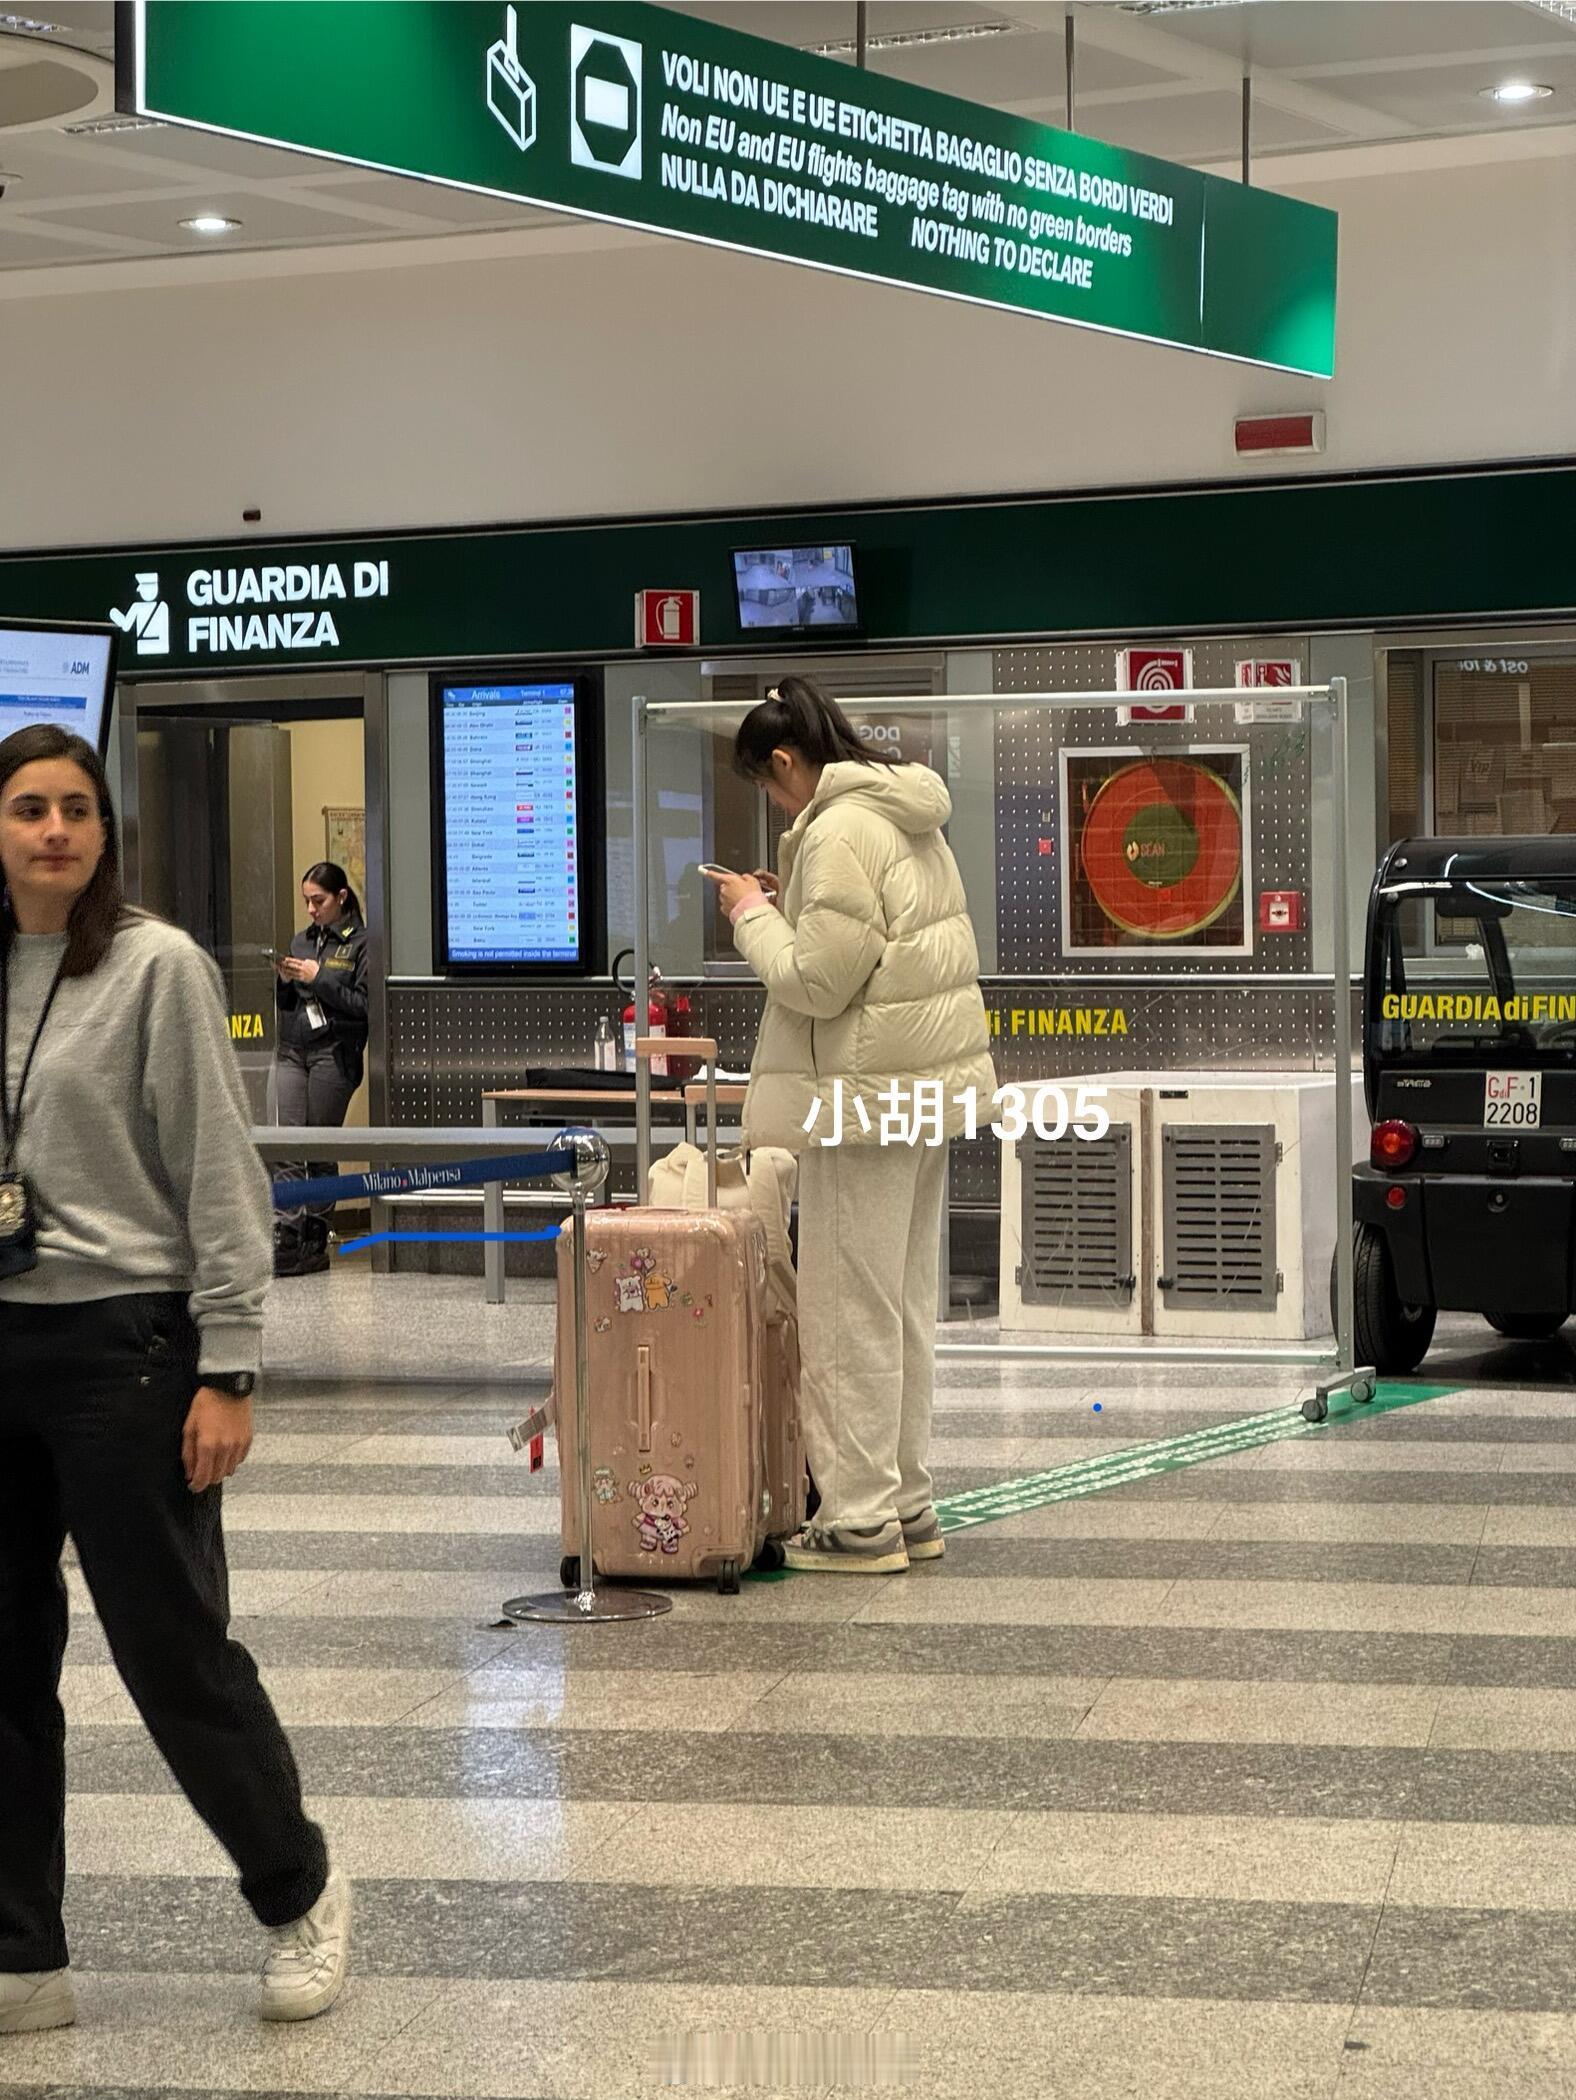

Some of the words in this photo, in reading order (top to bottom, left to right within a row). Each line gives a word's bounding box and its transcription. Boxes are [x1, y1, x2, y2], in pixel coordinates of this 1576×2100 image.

[662, 50, 709, 97] VOLI
[714, 65, 758, 111] NON
[763, 80, 789, 119] UE
[793, 88, 806, 124] E
[809, 93, 836, 132] UE
[838, 102, 933, 159] ETICHETTA
[936, 131, 1022, 184] BAGAGLIO
[1024, 156, 1077, 199] SENZA
[1079, 171, 1127, 214] BORDI
[1130, 186, 1173, 226] VERDI
[661, 102, 701, 145] Non
[705, 115, 736, 154] EU
[738, 132, 775, 164] and
[777, 134, 806, 172] EU
[808, 142, 862, 187] flights
[864, 158, 939, 211] baggage
[942, 181, 969, 221] tag
[971, 190, 1004, 223] with
[1007, 204, 1027, 230] no
[1030, 208, 1073, 242] green
[1076, 215, 1132, 257] borders
[661, 152, 727, 201] NULLA
[731, 170, 760, 209] DA
[763, 178, 878, 237] DICHIARARE
[911, 216, 990, 265] NOTHING
[993, 236, 1016, 271] TO
[1019, 243, 1093, 289] DECLARE
[186, 563, 346, 607] GUARDIA
[353, 561, 389, 598] DI
[188, 611, 339, 653] FINANZA
[70, 661, 90, 675] ADM
[1011, 1008, 1128, 1035] FINANZA
[1382, 994, 1501, 1021] GUARDIA
[1503, 994, 1528, 1021] di
[1487, 1102, 1538, 1125] 2208
[362, 1170, 401, 1192] Milano
[408, 1166, 461, 1188] Malpensa
